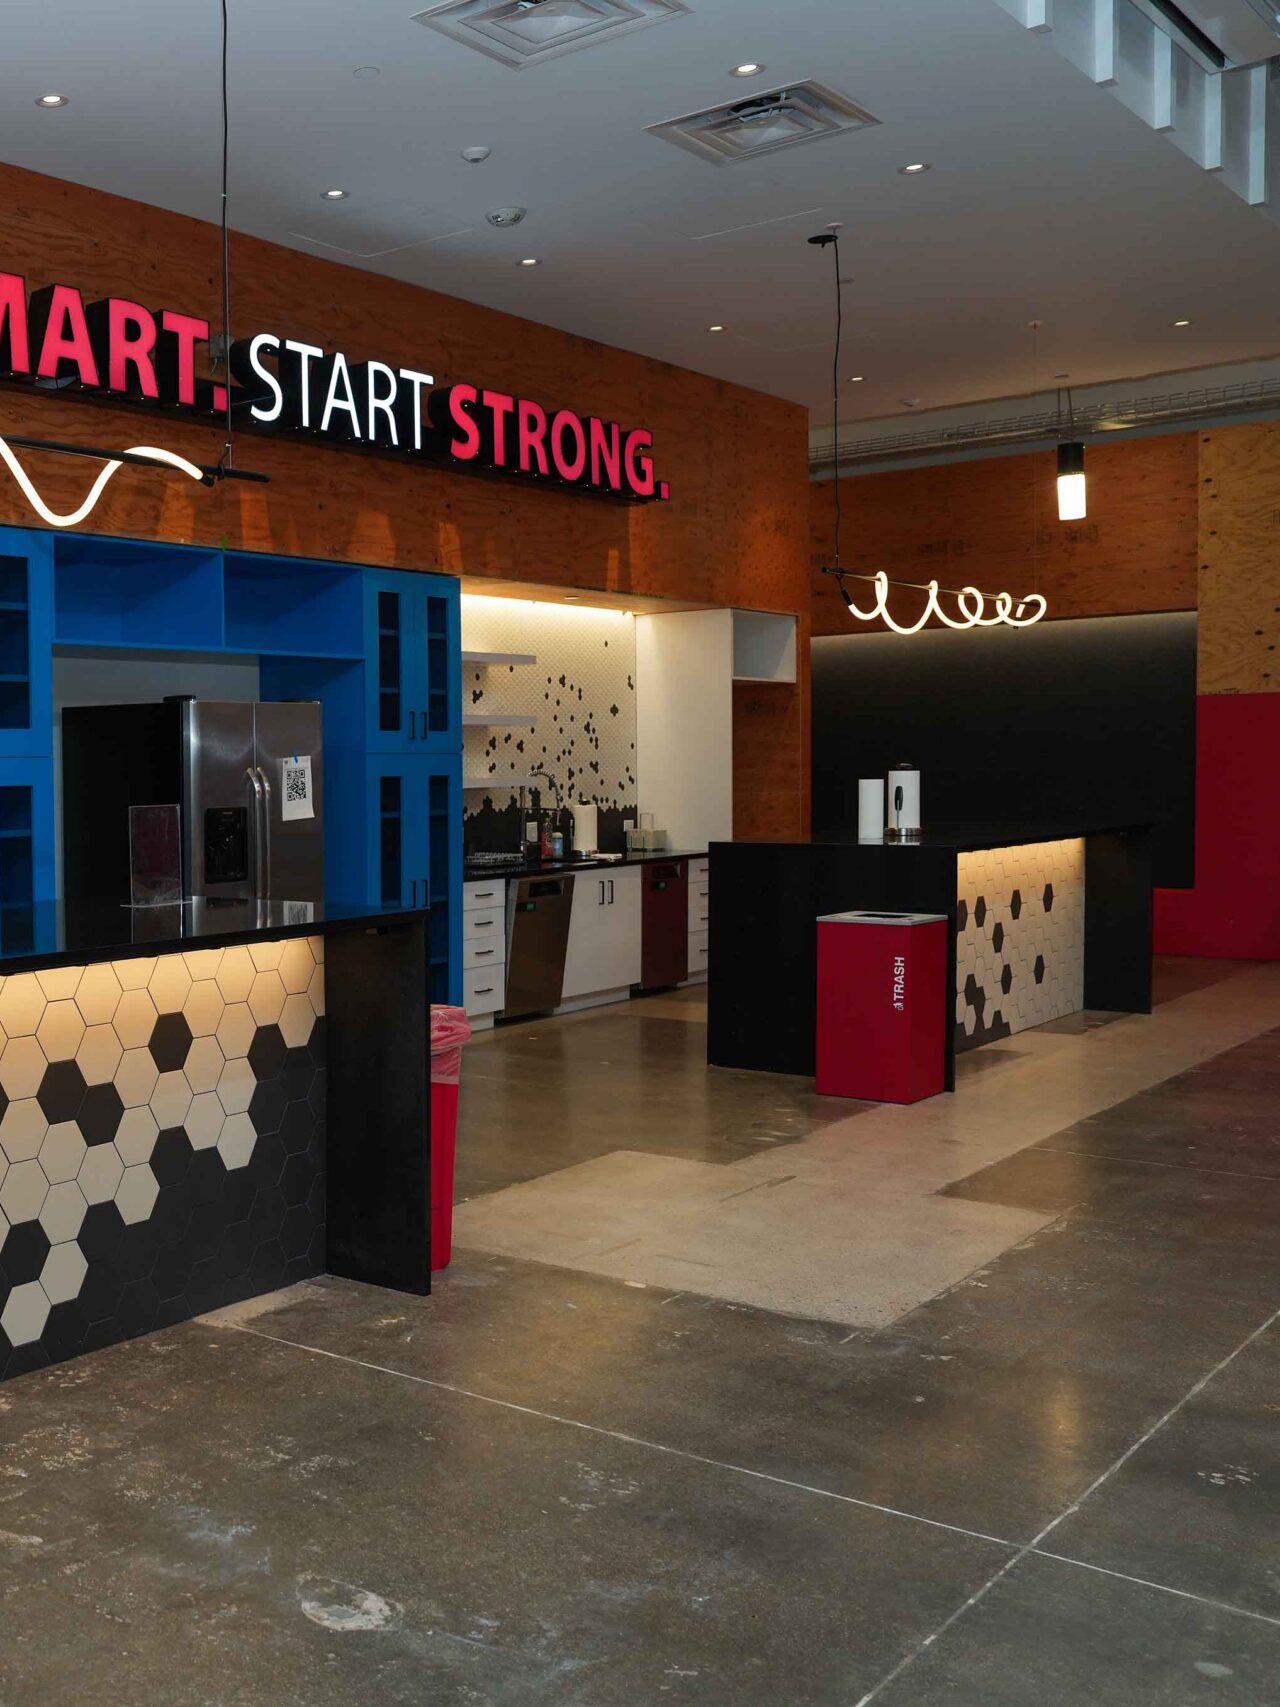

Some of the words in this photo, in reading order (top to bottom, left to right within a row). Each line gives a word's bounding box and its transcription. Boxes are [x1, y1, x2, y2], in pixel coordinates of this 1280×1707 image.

[249, 332, 435, 450] START
[449, 383, 670, 499] STRONG.
[893, 956, 905, 1001] TRASH
